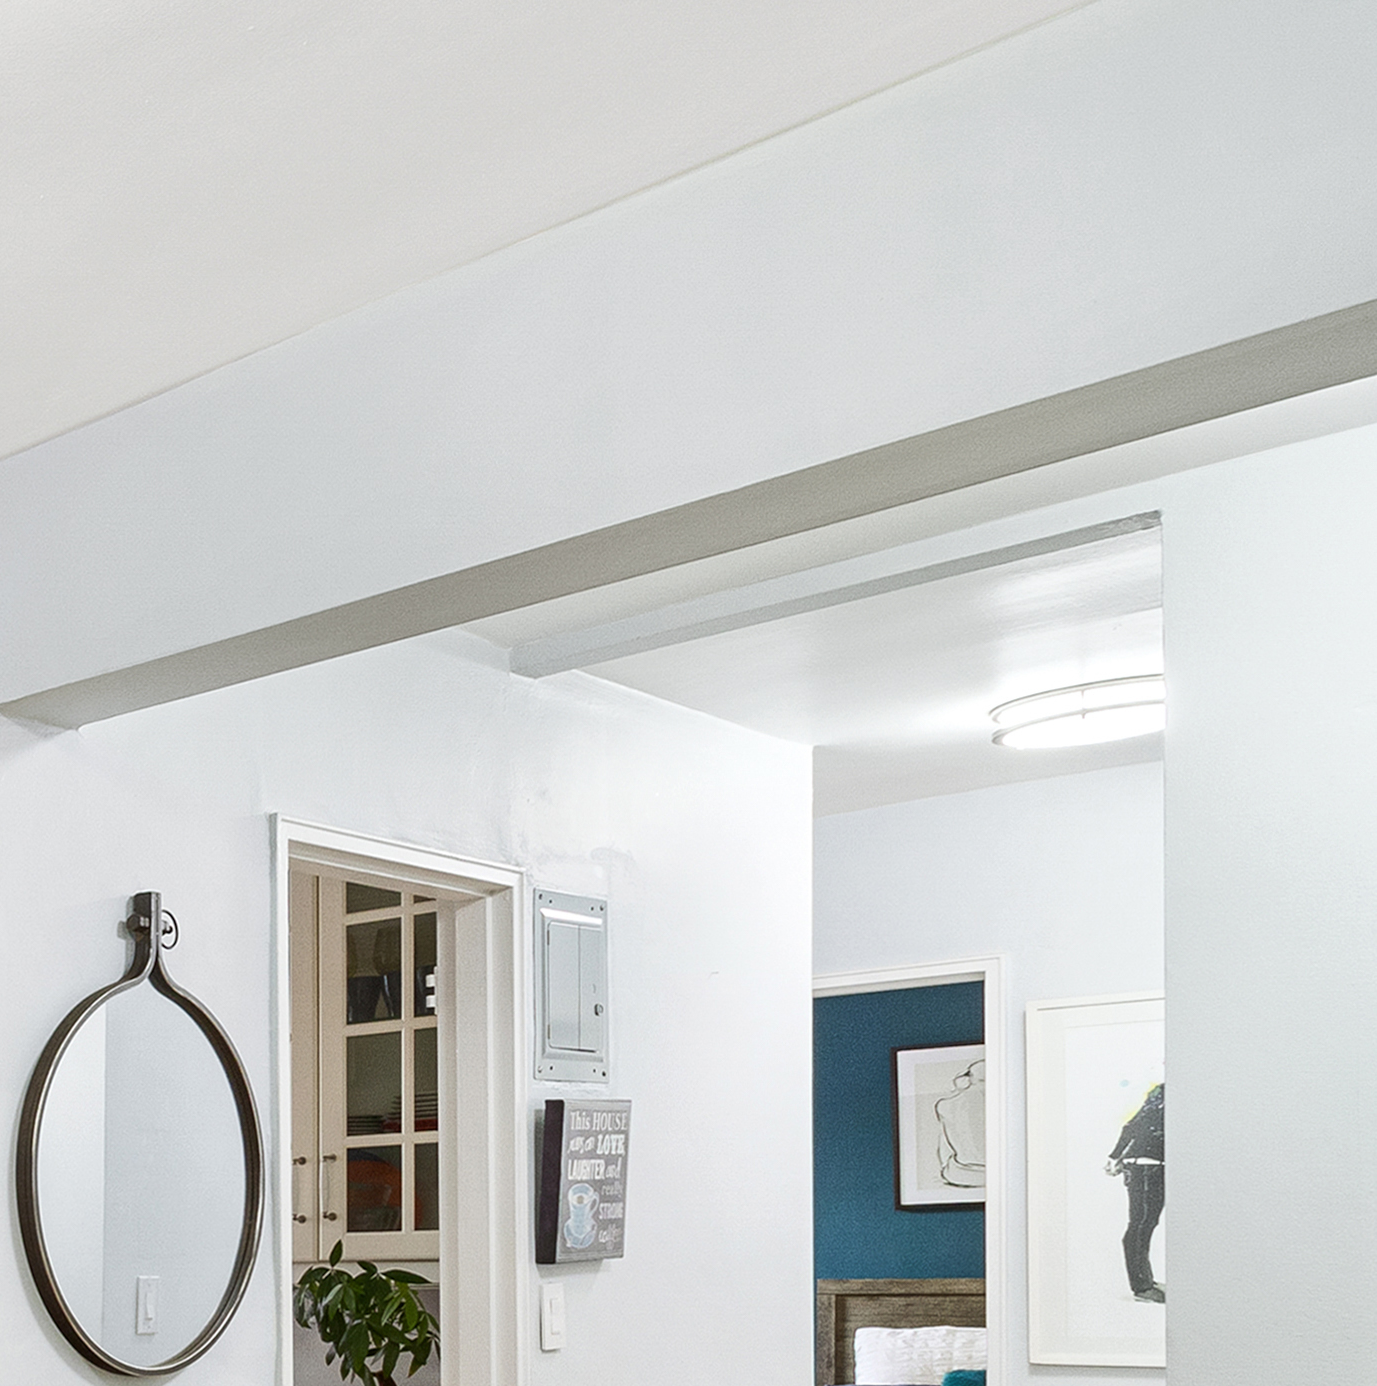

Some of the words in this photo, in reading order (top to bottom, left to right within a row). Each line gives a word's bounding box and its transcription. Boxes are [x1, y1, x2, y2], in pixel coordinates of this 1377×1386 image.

[570, 1111, 591, 1130] This
[593, 1112, 627, 1131] HOUSE
[568, 1159, 605, 1180] LAUGHTER
[606, 1157, 622, 1179] and
[599, 1202, 623, 1219] STRONG
